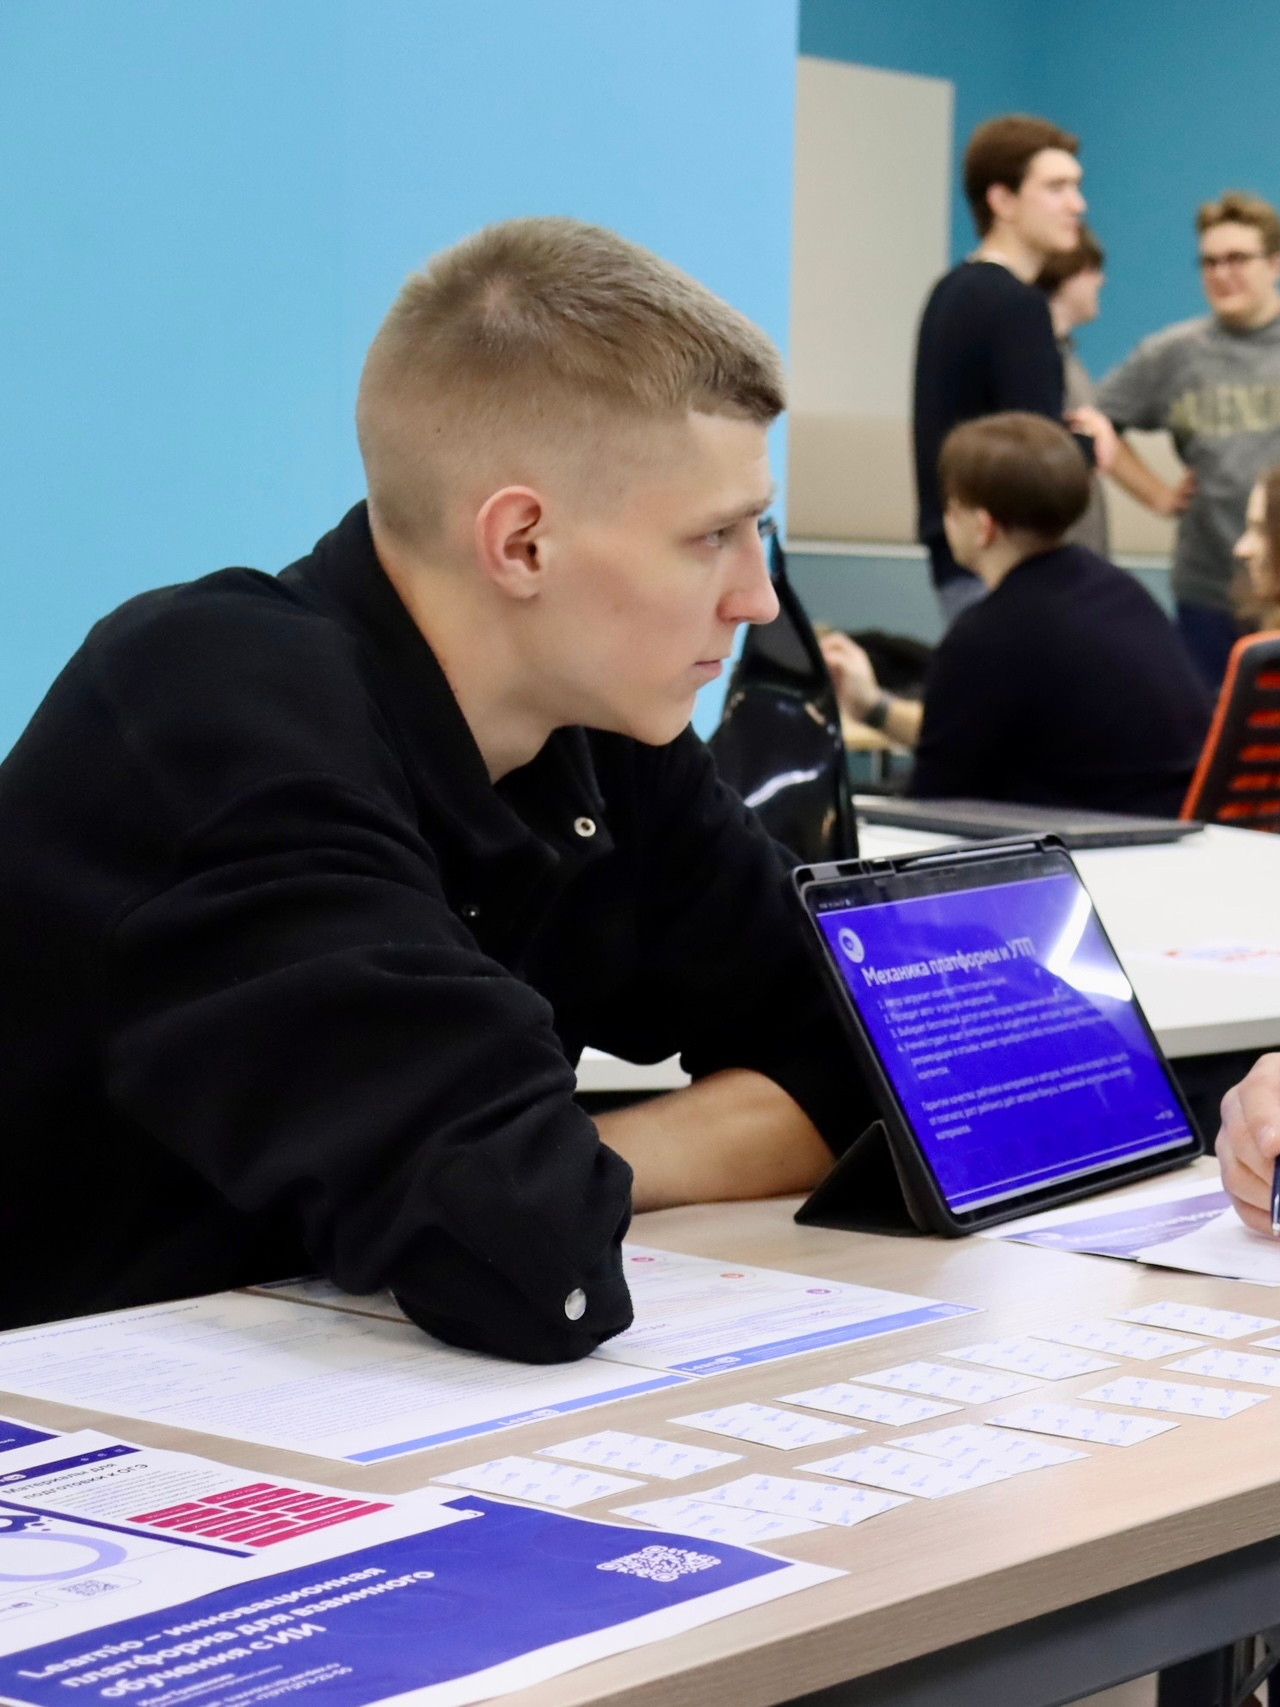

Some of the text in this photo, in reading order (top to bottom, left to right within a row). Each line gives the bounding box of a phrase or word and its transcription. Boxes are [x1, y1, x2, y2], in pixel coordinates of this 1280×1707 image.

[861, 936, 1036, 987] Механика платформы и УТП
[2, 1468, 88, 1495] Материалы
[88, 1462, 118, 1478] для
[23, 1474, 107, 1500] подготовки
[117, 1462, 148, 1475] ОГЭ
[17, 1638, 145, 1681] Learnio
[162, 1566, 387, 1637] инновационная
[61, 1629, 241, 1689] платформа
[236, 1612, 296, 1638] для
[291, 1569, 436, 1619] взаимного
[100, 1646, 253, 1699] обучения
[249, 1637, 274, 1653] с
[270, 1620, 328, 1647] ИИ
